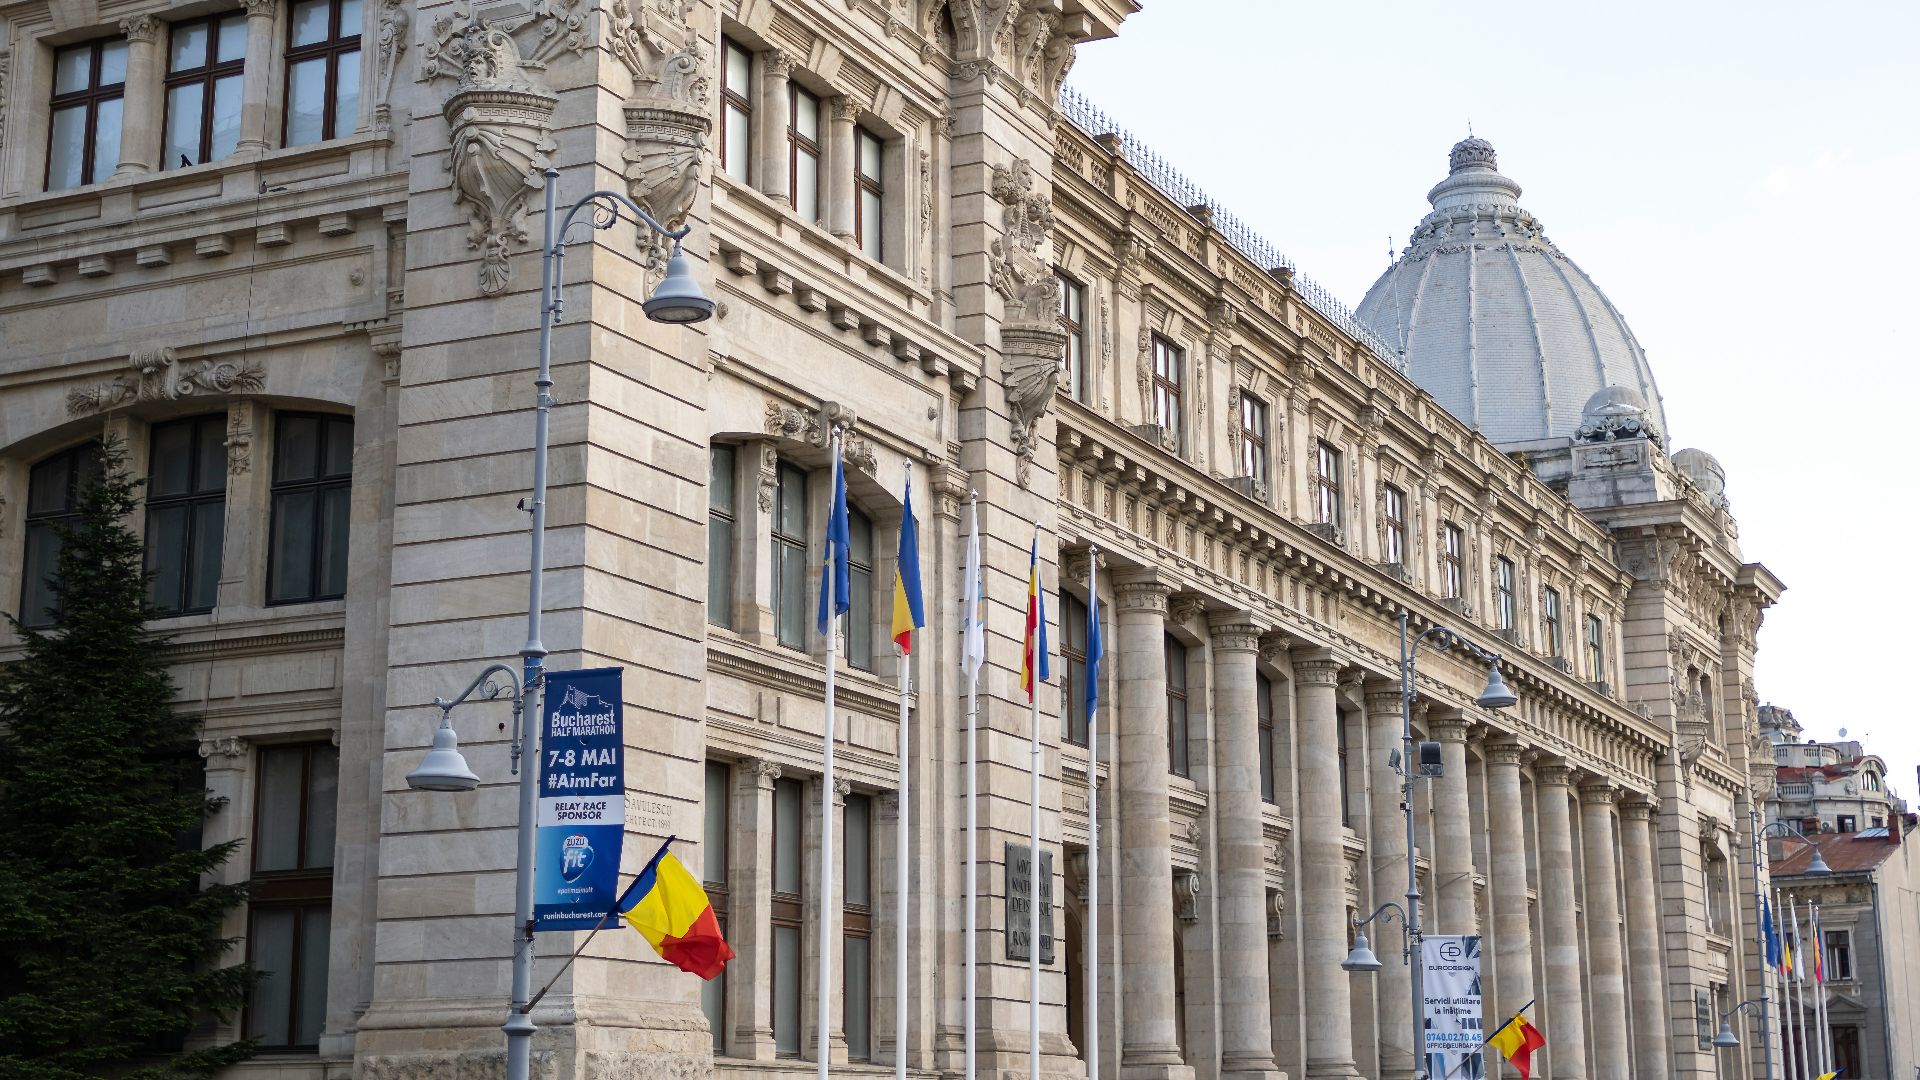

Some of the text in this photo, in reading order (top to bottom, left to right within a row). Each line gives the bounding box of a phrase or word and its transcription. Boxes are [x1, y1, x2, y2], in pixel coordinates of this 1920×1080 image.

[551, 710, 616, 728] Bucharest
[551, 725, 616, 737] HALF MARATHON
[548, 748, 616, 767] 7-8 MAI
[548, 772, 617, 789] #AimFar
[555, 801, 607, 811] RELAY RACE
[557, 811, 602, 820] SPONSOR
[566, 838, 585, 846] ZUZU
[563, 849, 587, 873] fit
[1424, 997, 1481, 1005] Servicii utilitare
[1434, 1007, 1441, 1015] la
[1426, 1033, 1482, 1041] 0740.02.70.45
